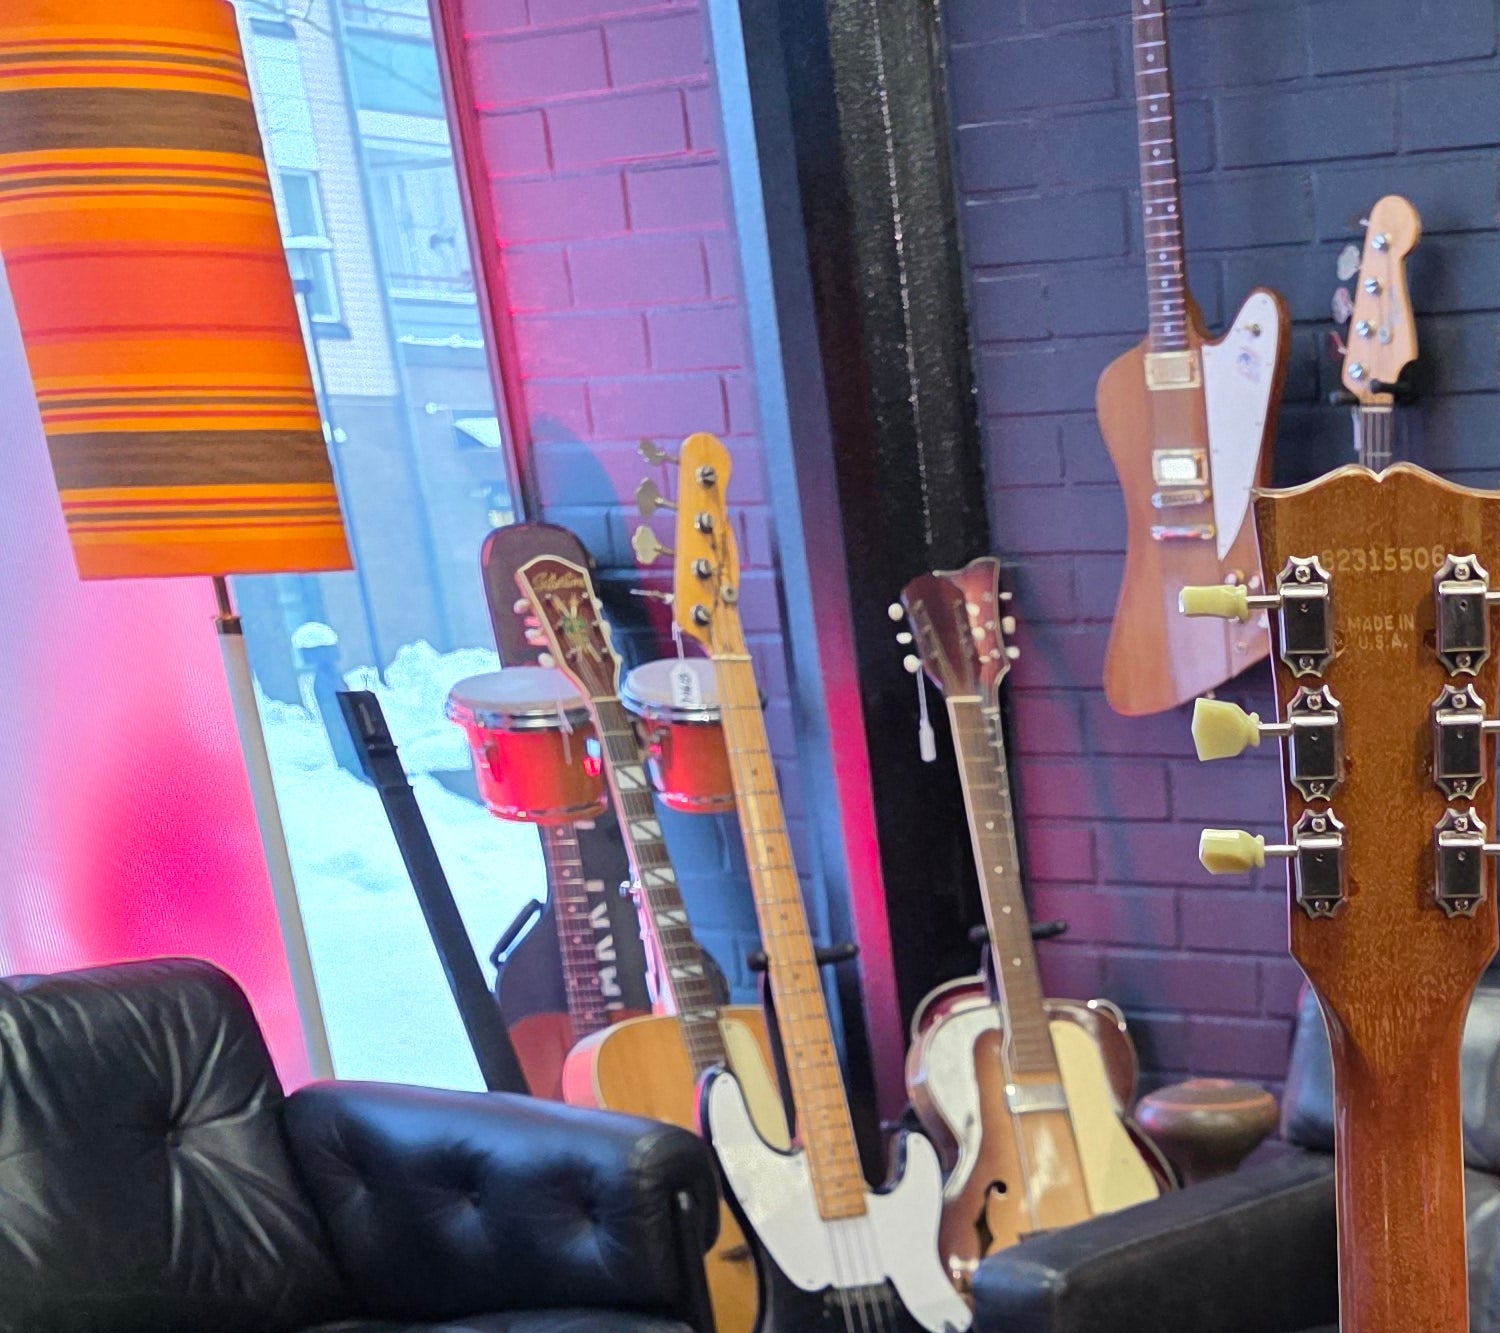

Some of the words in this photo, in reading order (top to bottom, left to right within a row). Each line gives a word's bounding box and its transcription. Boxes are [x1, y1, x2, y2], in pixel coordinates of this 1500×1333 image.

[1347, 614, 1394, 632] MADE
[1399, 613, 1415, 631] IN
[1358, 632, 1409, 649] U.S.A.
